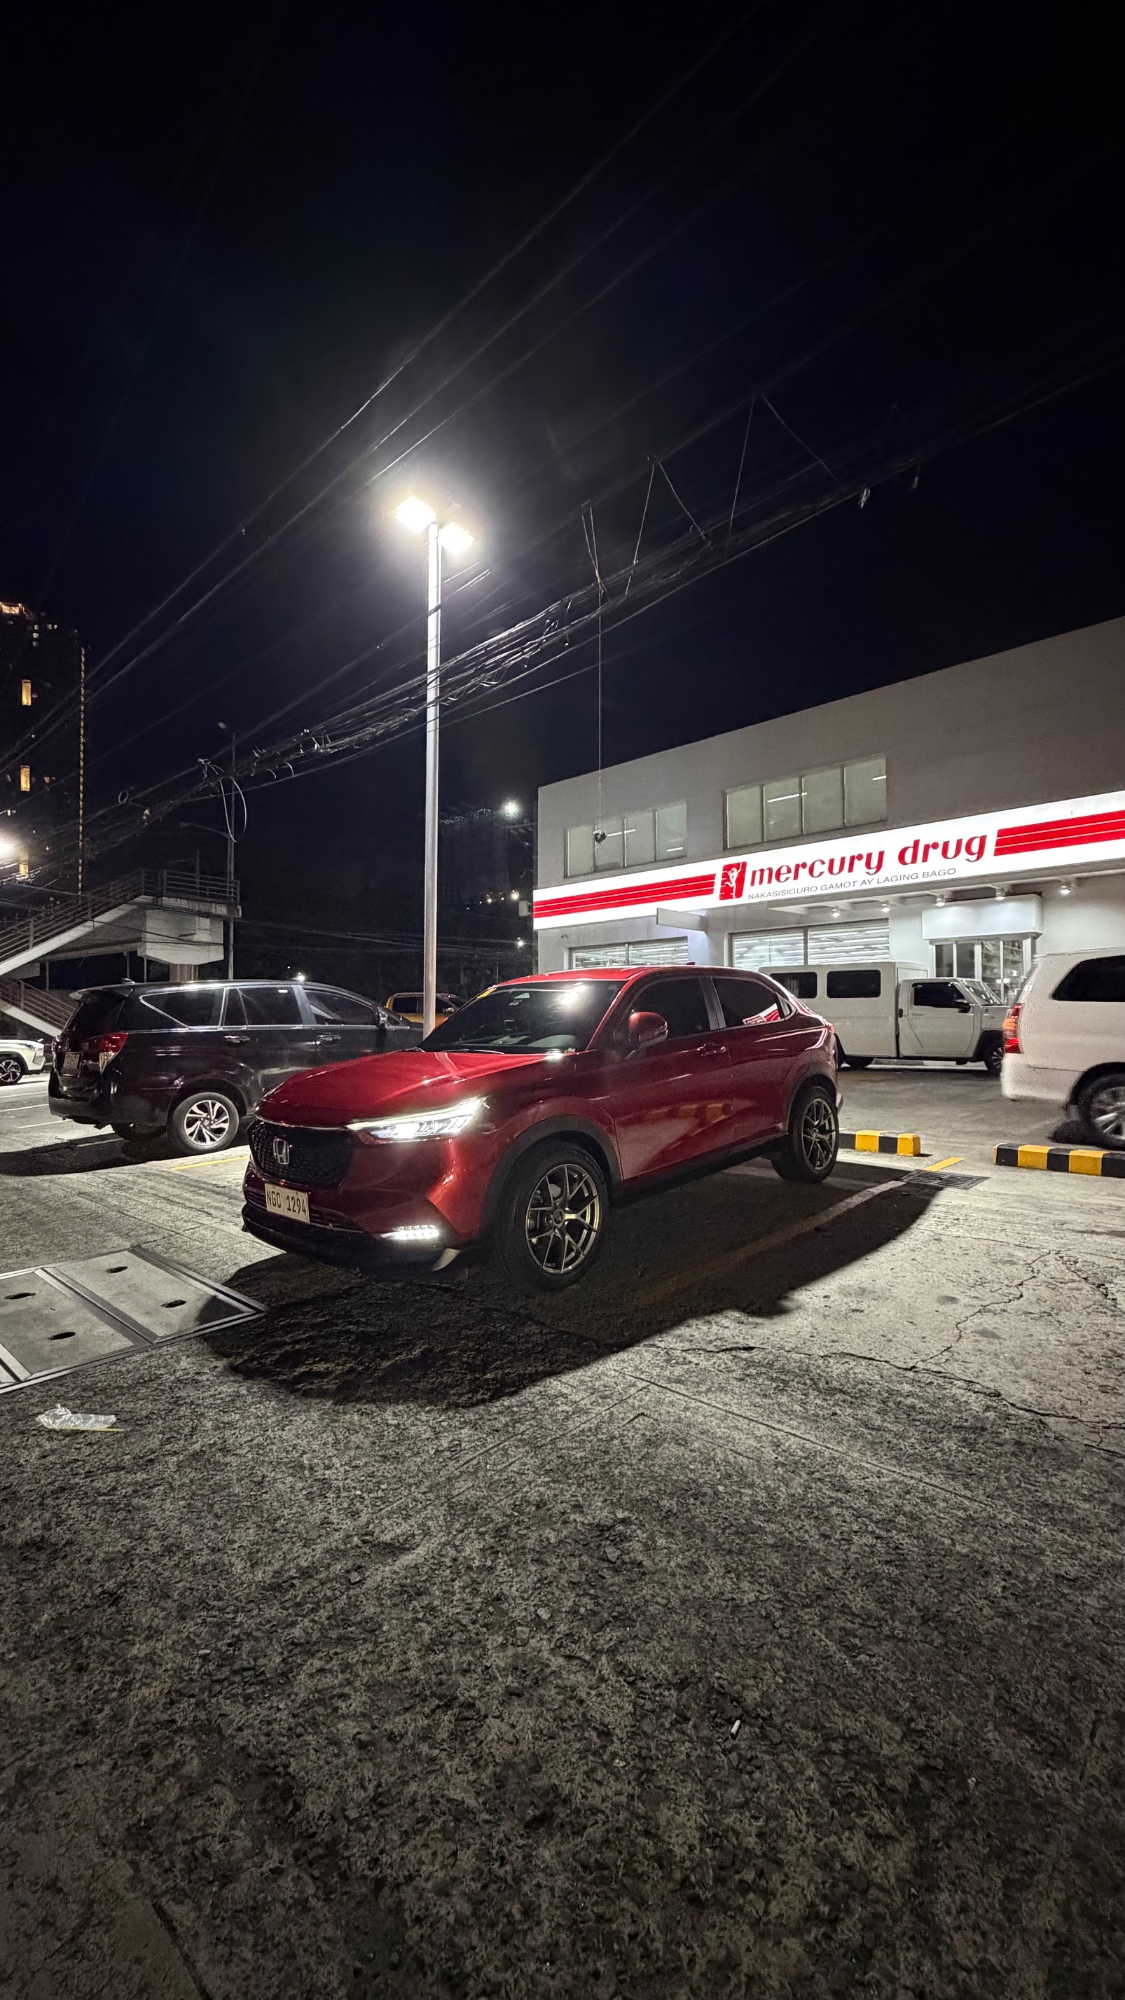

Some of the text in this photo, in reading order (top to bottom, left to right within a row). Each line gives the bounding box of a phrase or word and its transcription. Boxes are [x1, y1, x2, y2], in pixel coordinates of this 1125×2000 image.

[750, 834, 987, 887] mercury drug
[747, 867, 957, 900] NAKASISIGURO GAMOT AY LAGING BAGO
[285, 1195, 307, 1217] 1294
